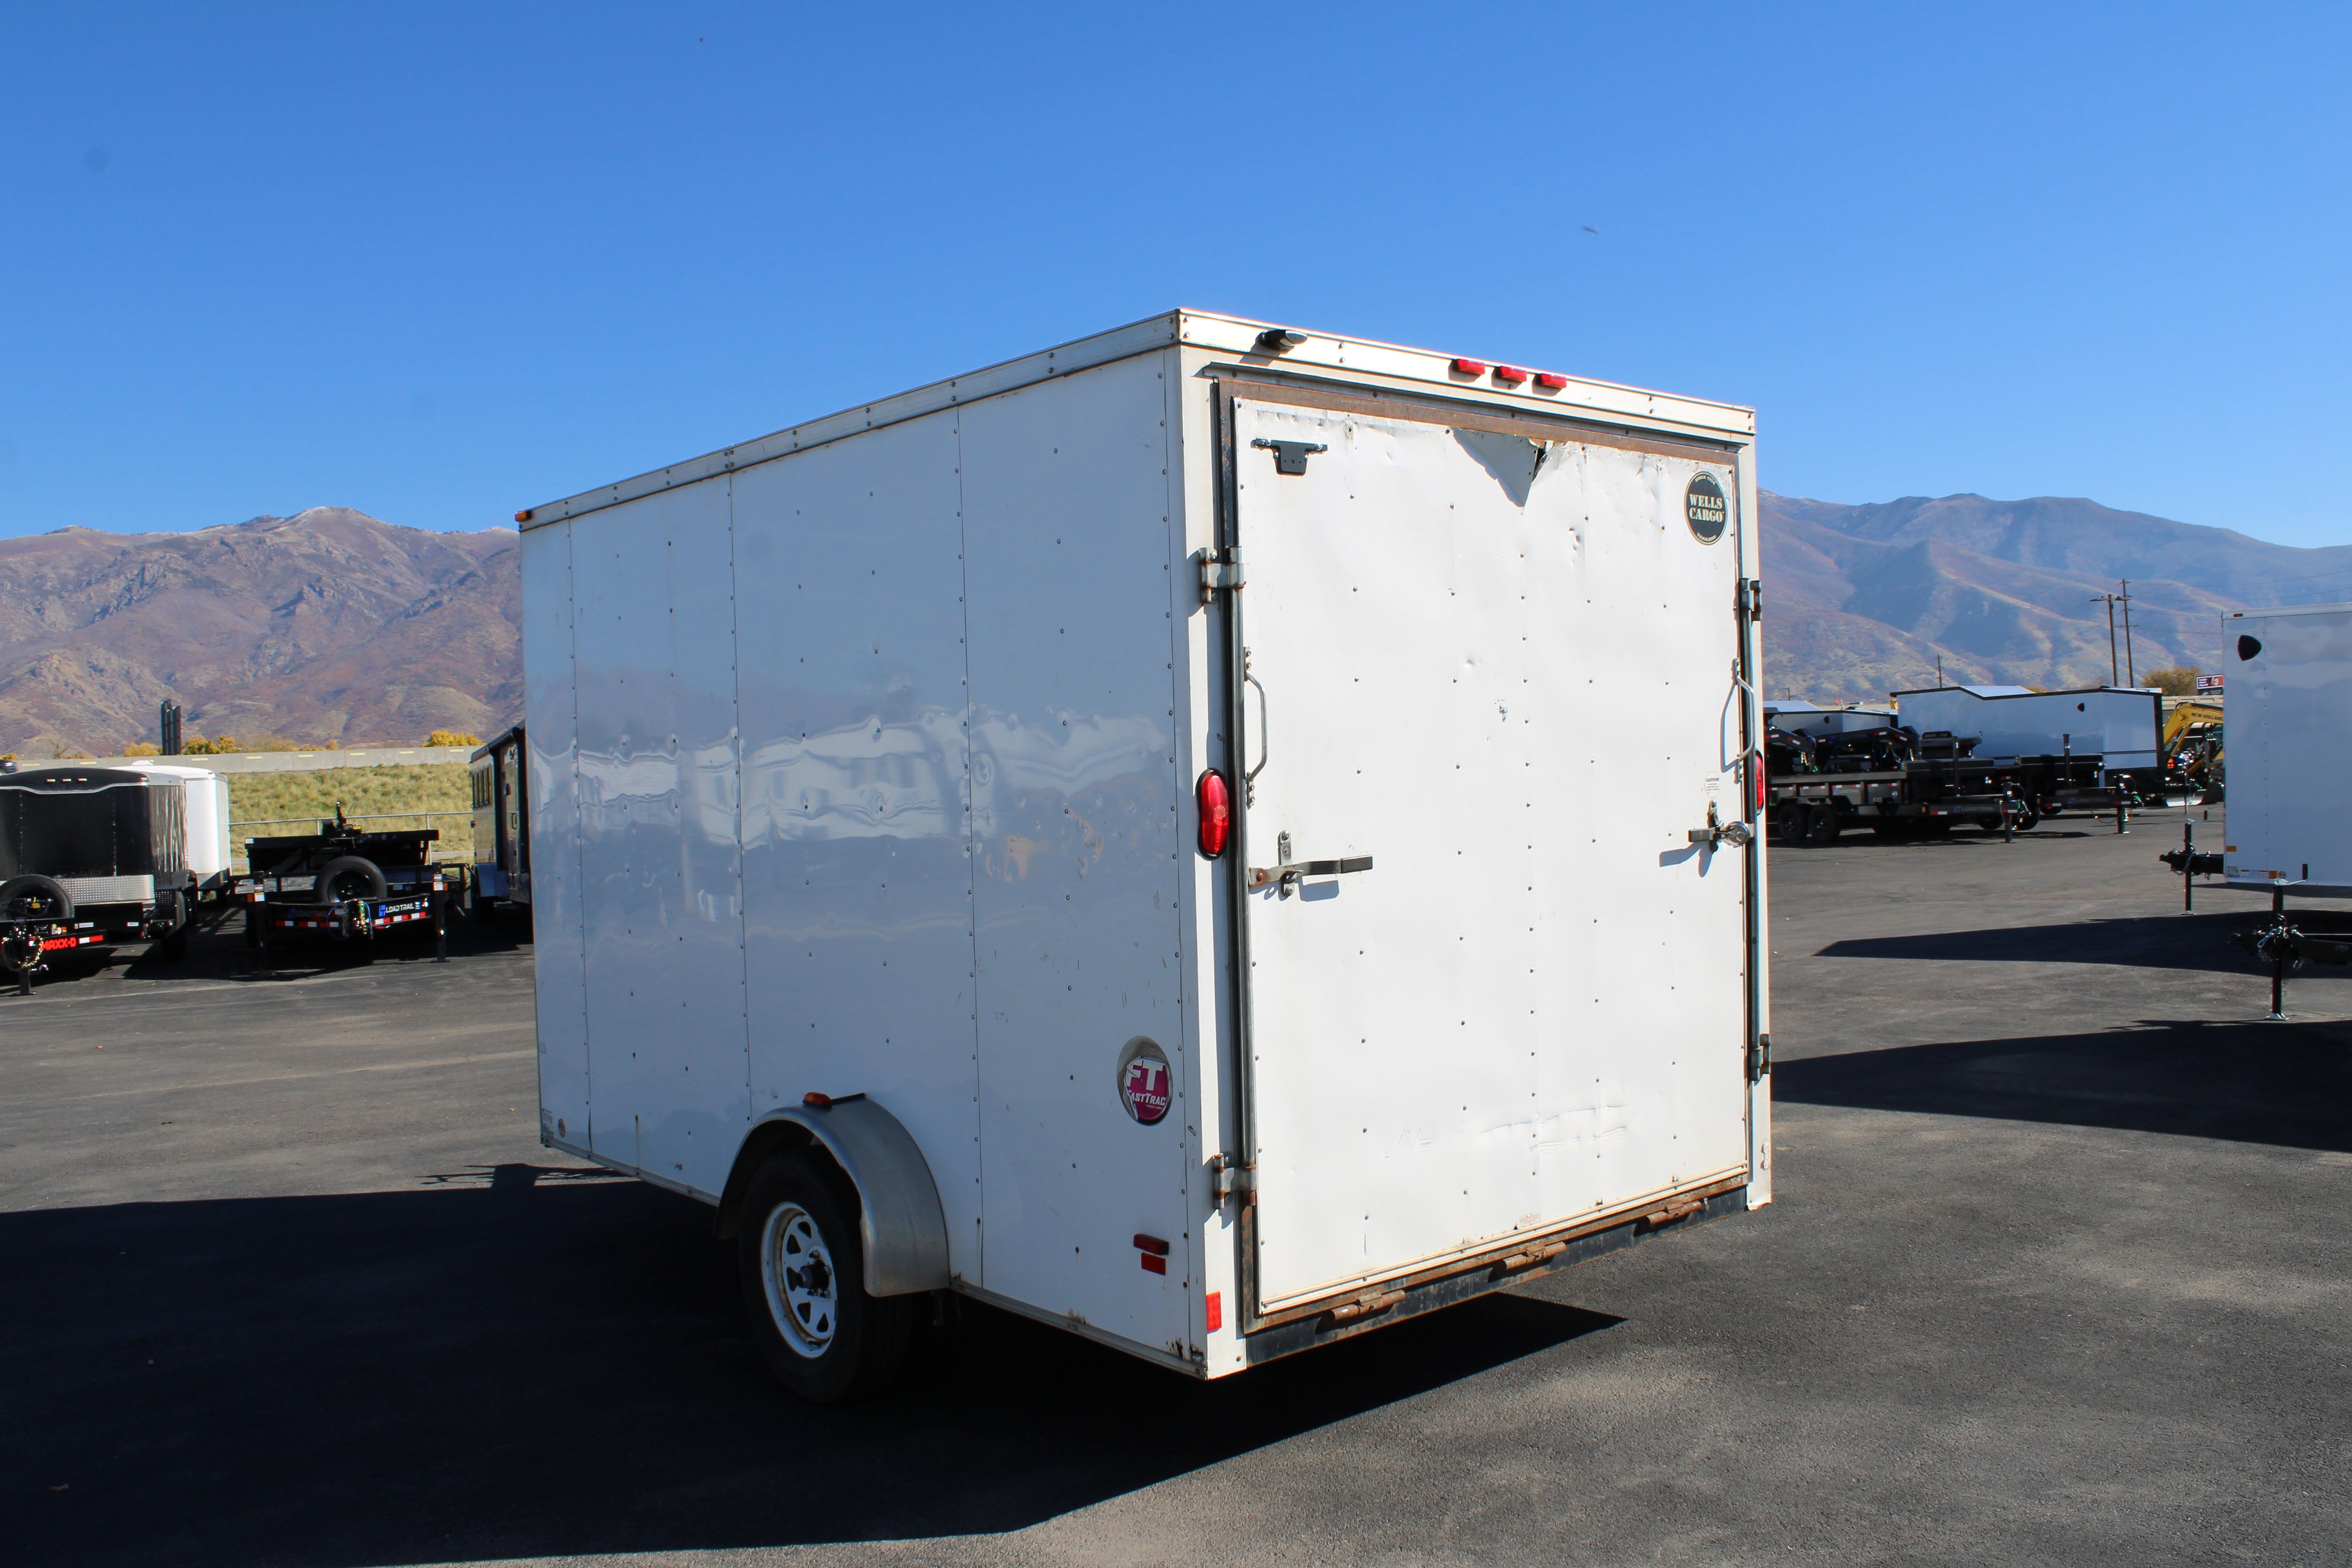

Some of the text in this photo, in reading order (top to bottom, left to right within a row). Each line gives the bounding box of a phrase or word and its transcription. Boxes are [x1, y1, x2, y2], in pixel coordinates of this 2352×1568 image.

[1689, 494, 1723, 510] WELLS
[1689, 508, 1723, 523] CARGO
[1697, 532, 1716, 541] TRAILERS
[42, 938, 76, 950] MAXX-D
[1125, 1058, 1163, 1091] FT
